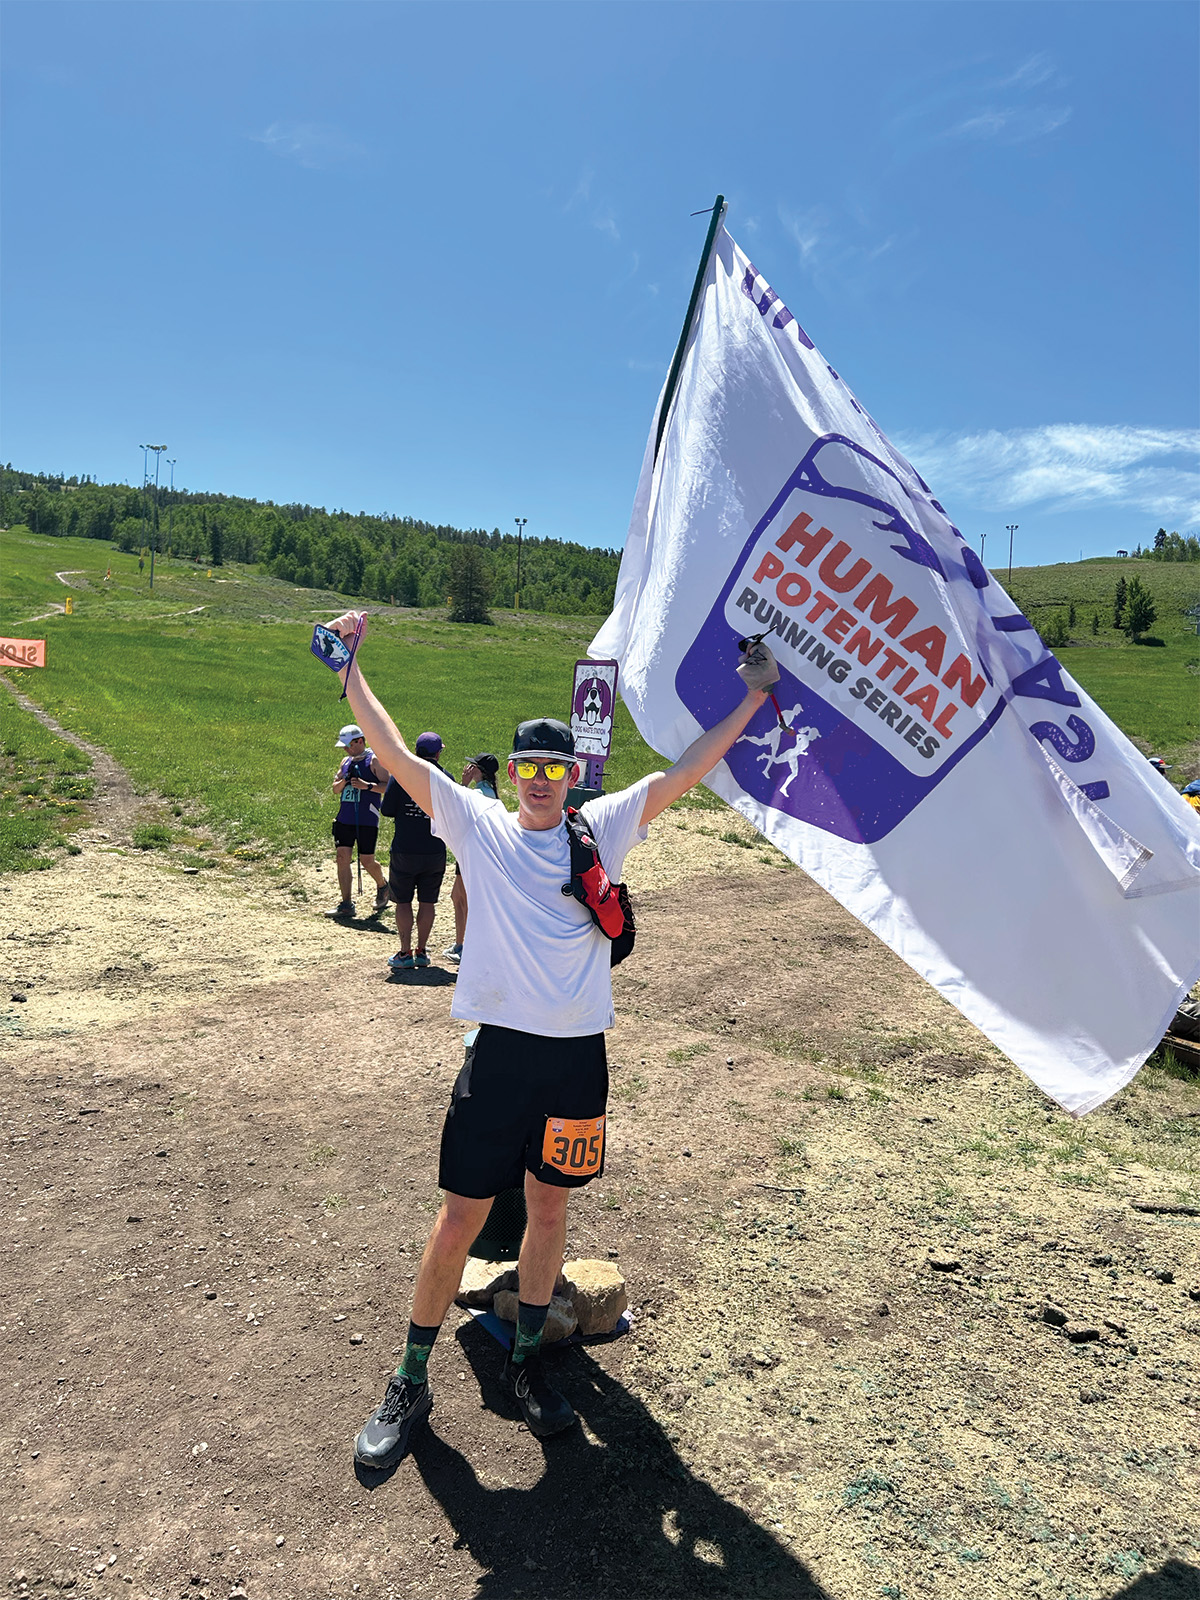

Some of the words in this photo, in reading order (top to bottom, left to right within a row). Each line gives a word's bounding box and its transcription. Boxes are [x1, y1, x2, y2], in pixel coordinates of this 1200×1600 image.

[317, 627, 349, 657] SUMMITS
[752, 550, 959, 740] POTENTIAL
[775, 511, 987, 708] HUMAN
[735, 586, 852, 683] RUNNING
[849, 676, 941, 760] SERIES
[575, 725, 583, 733] DOG
[551, 1135, 600, 1168] 305
